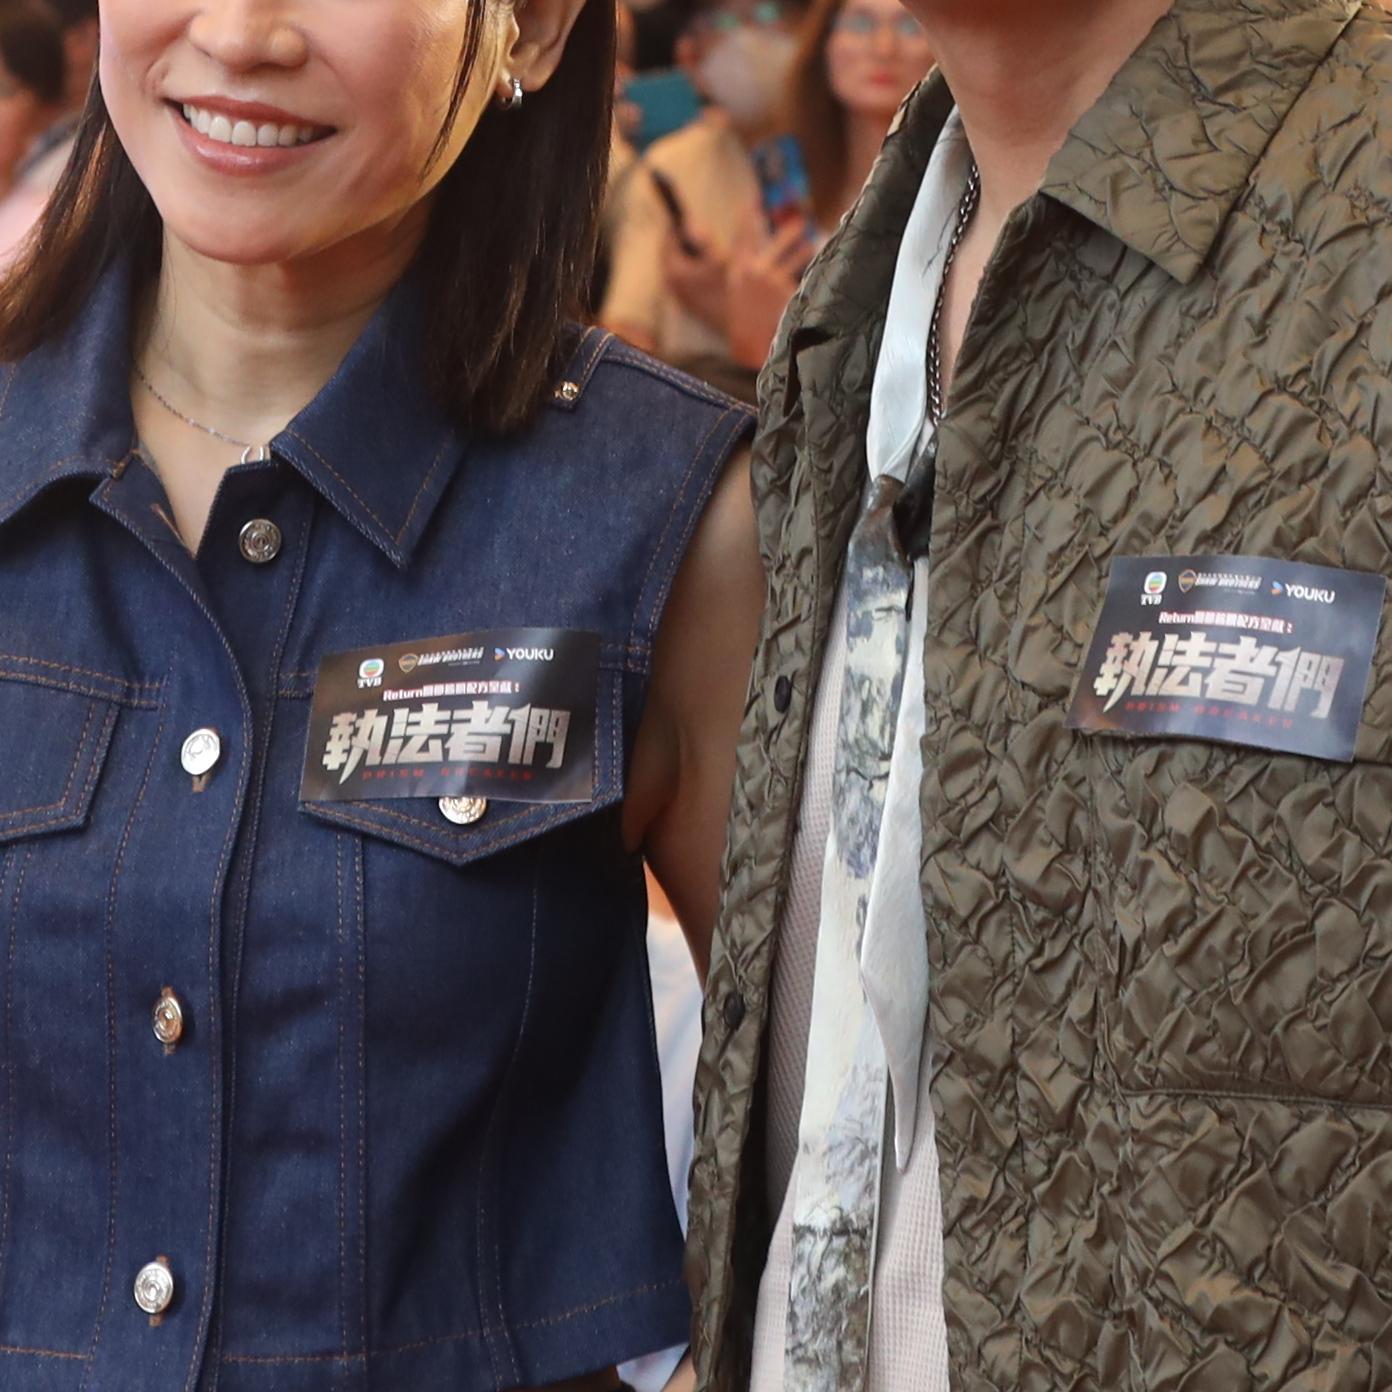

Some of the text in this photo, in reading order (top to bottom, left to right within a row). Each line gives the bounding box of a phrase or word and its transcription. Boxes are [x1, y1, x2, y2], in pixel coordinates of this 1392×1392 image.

[1284, 583, 1336, 604] YOUKU
[506, 646, 554, 662] YOUKU
[357, 677, 382, 689] TVB
[1093, 630, 1345, 720] 執法者們
[322, 700, 571, 785] 執法者們
